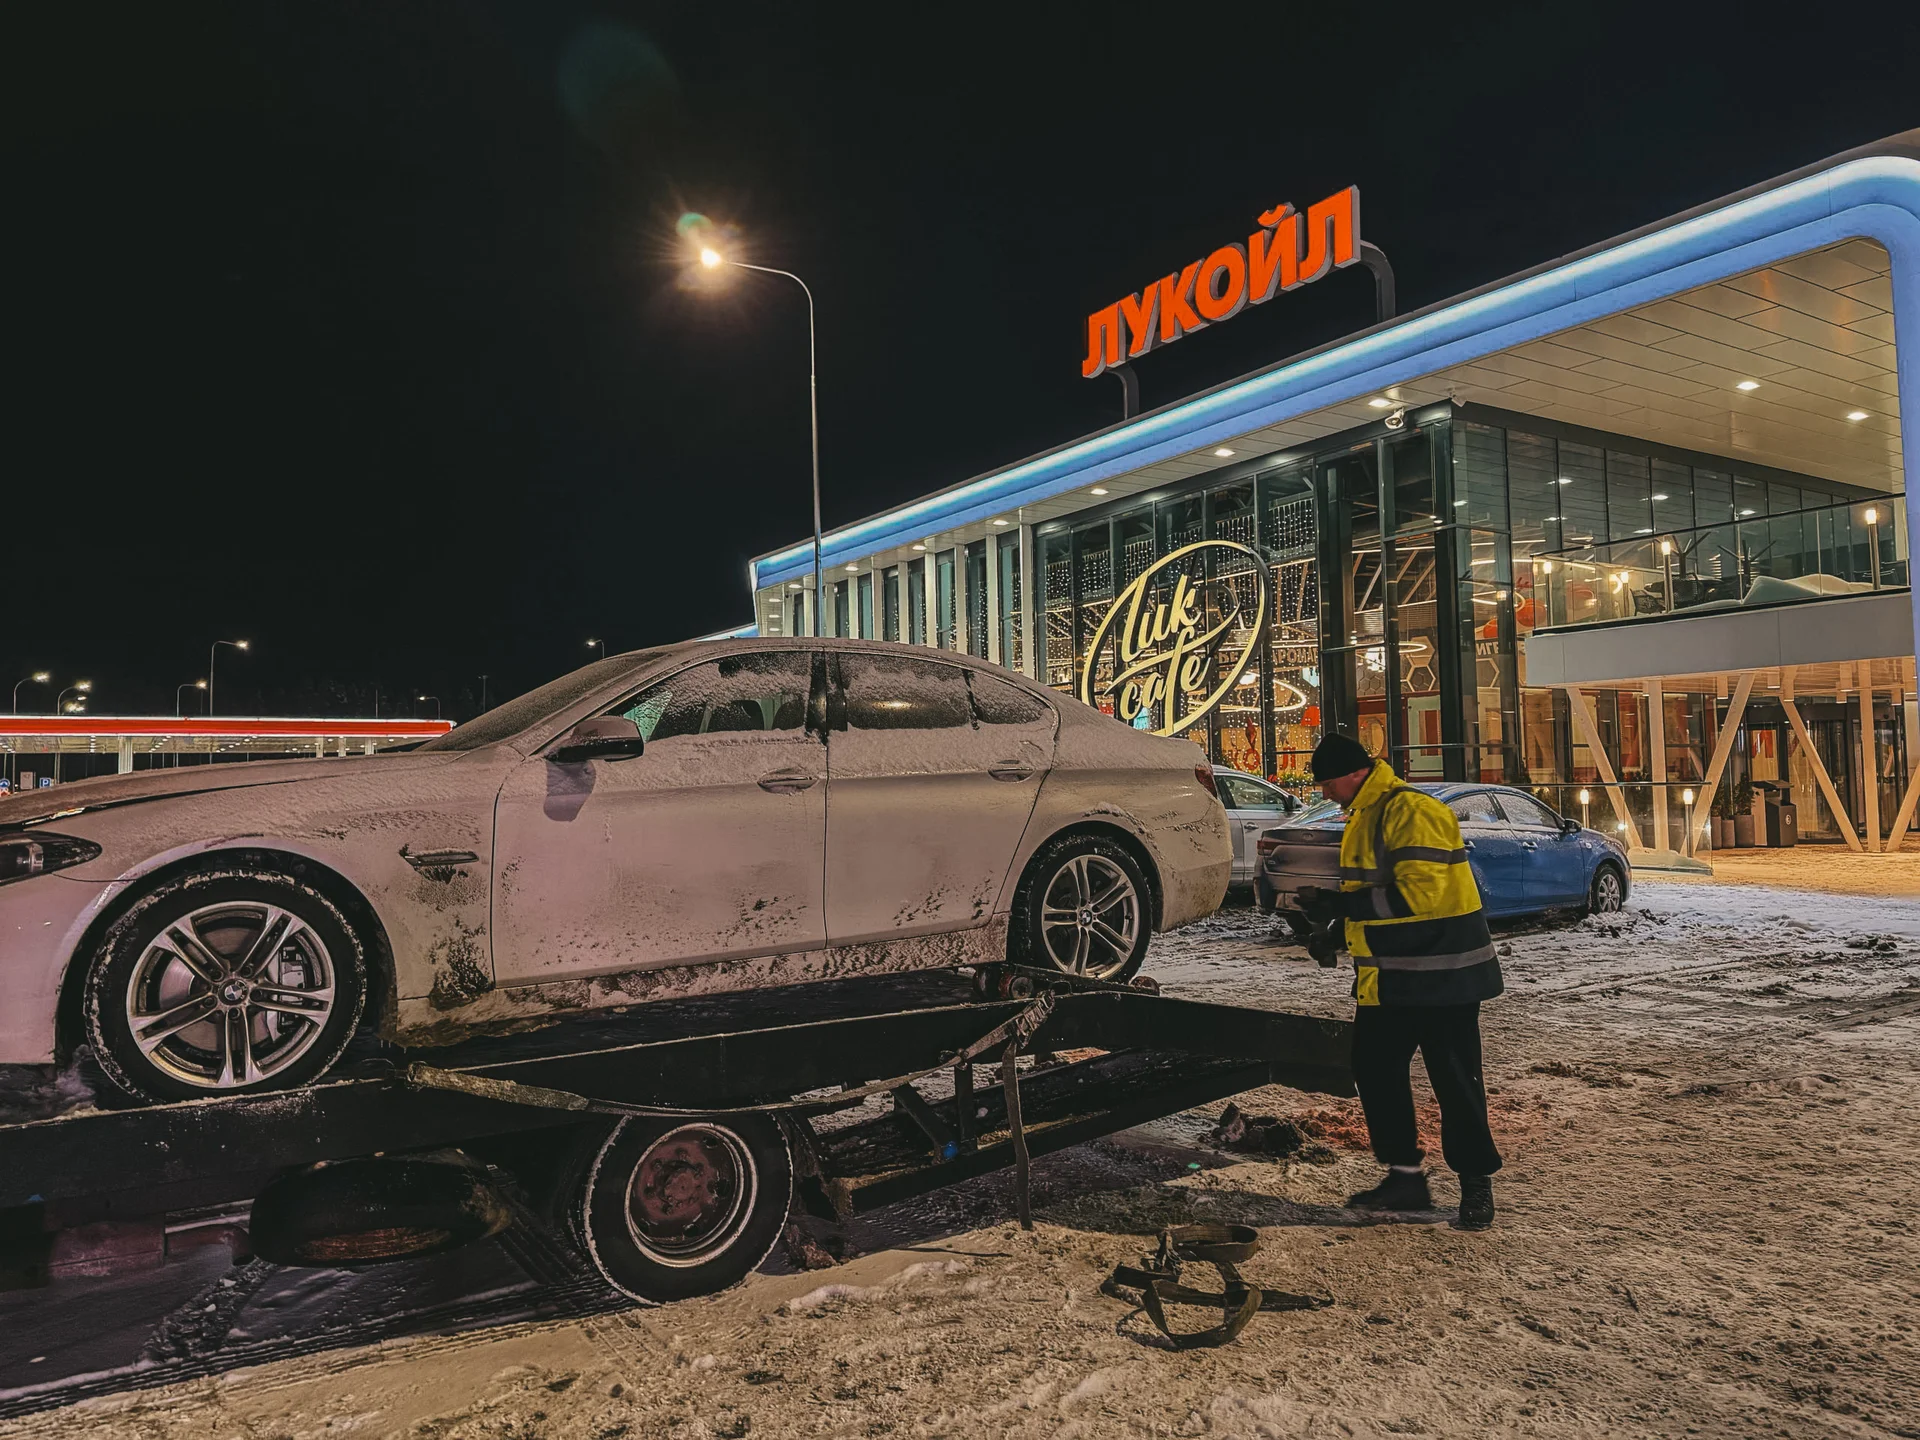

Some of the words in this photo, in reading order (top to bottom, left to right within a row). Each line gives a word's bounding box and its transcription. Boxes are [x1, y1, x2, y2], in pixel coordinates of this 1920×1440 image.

[1082, 184, 1361, 378] ЛУКОЙЛ
[1122, 569, 1201, 662] Luk
[1120, 626, 1211, 735] cafe
